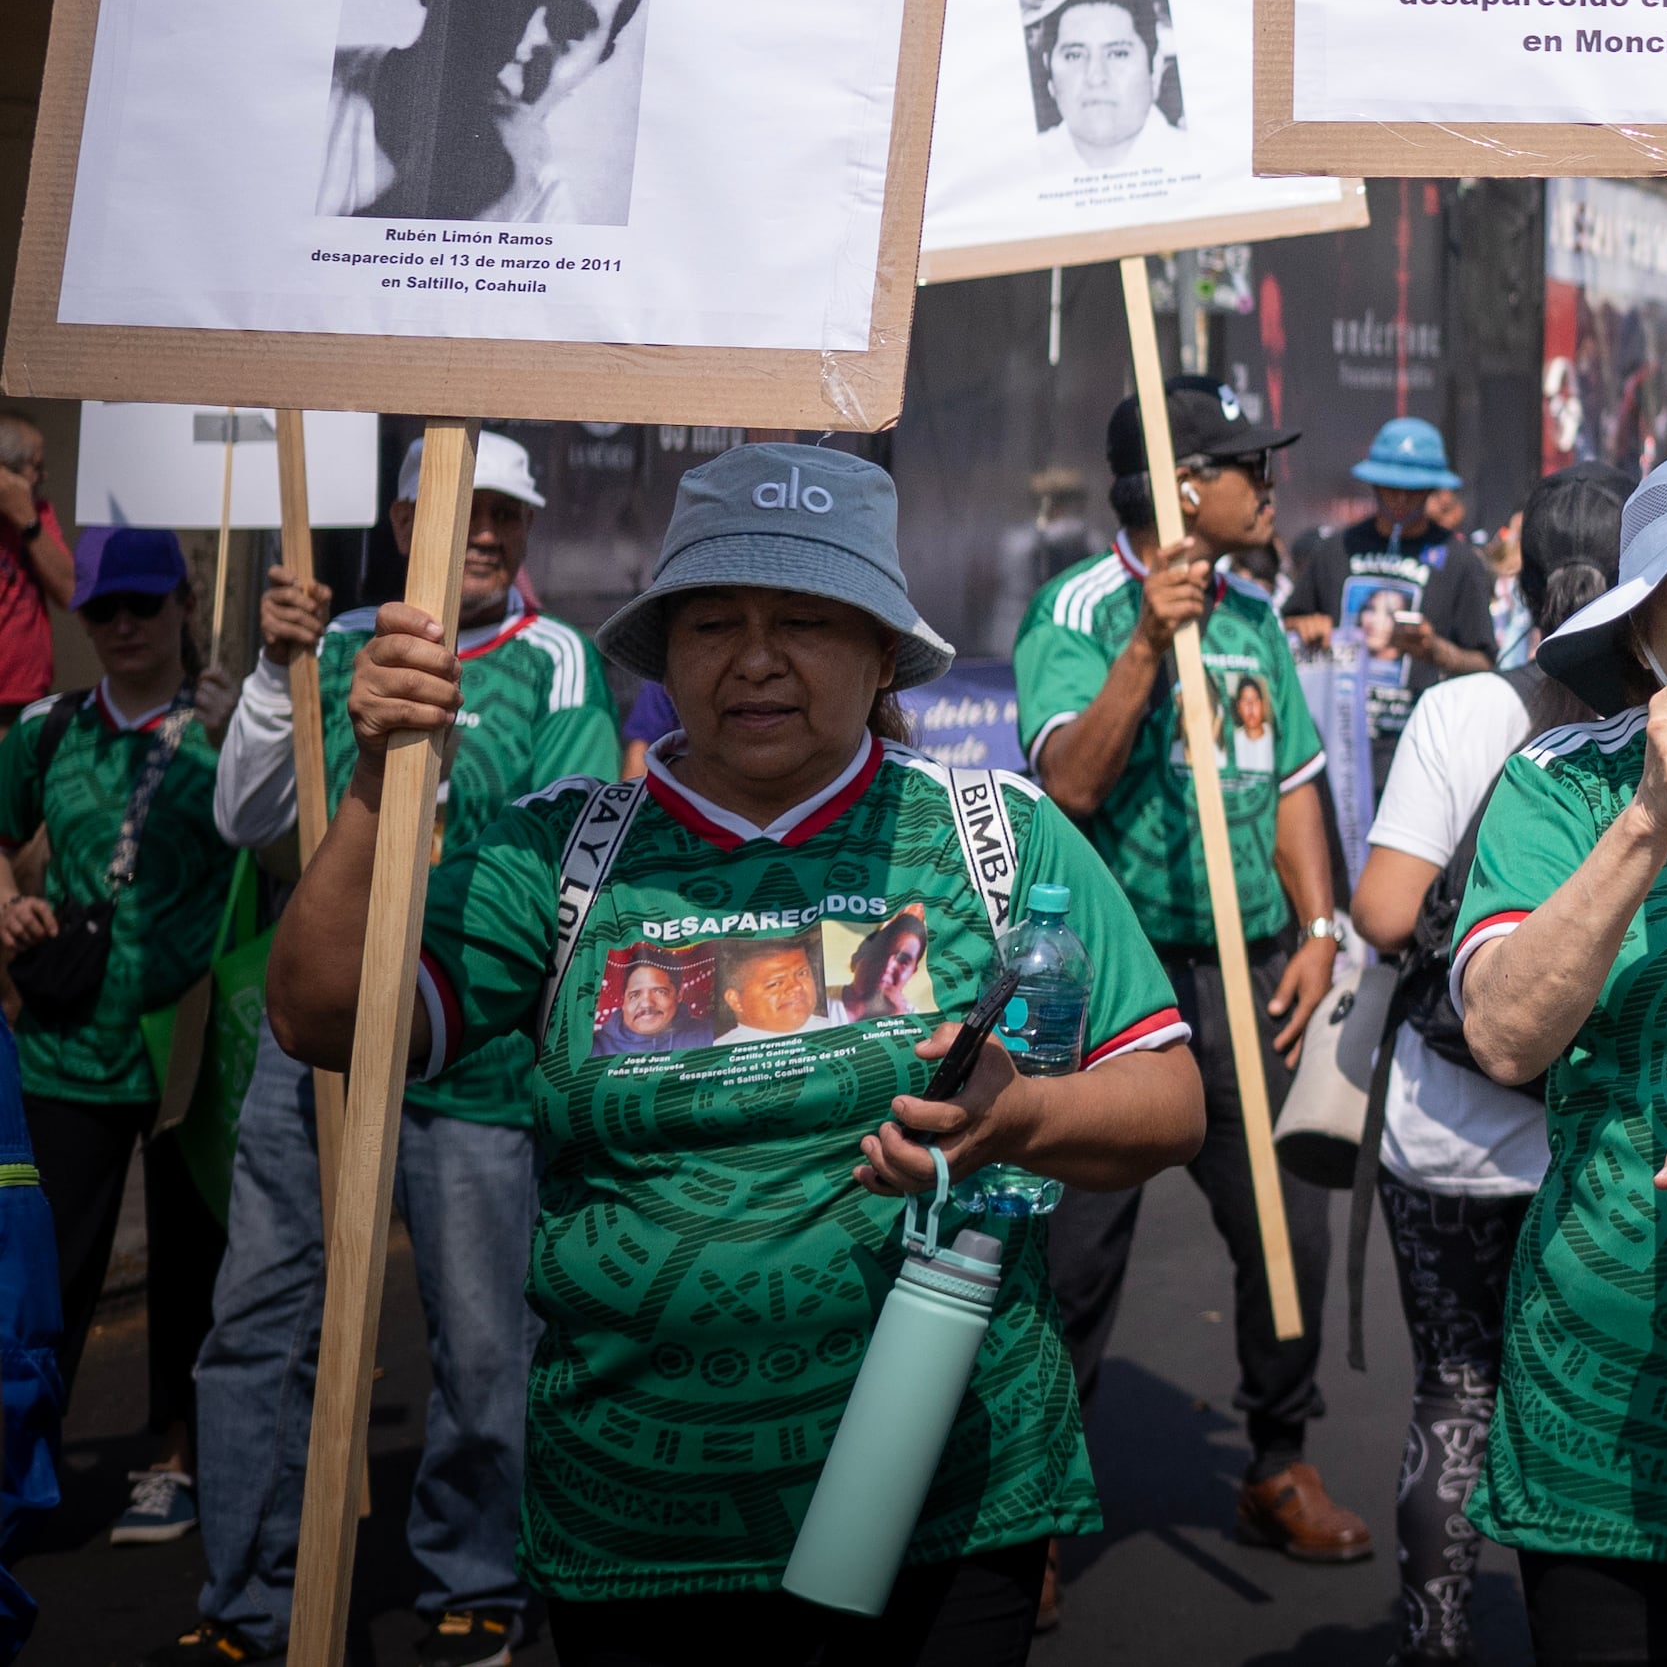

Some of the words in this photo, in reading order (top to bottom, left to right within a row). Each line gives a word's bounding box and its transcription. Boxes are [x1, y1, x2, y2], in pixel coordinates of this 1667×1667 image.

[1522, 35, 1562, 52] en
[385, 228, 437, 242] Rubén
[442, 230, 492, 244] Limón
[498, 232, 553, 246] Ramos
[311, 249, 425, 266] desaparecido
[429, 253, 444, 266] el
[450, 254, 470, 267] 13
[475, 255, 496, 268] de
[500, 259, 551, 269] marzo
[555, 257, 576, 270] de
[580, 258, 621, 272] 2011
[381, 278, 401, 288] en
[406, 276, 469, 294] Saltillo,
[475, 278, 547, 293] Coahuila
[752, 466, 834, 514] alo
[642, 894, 888, 941] DESAPARECIDOS
